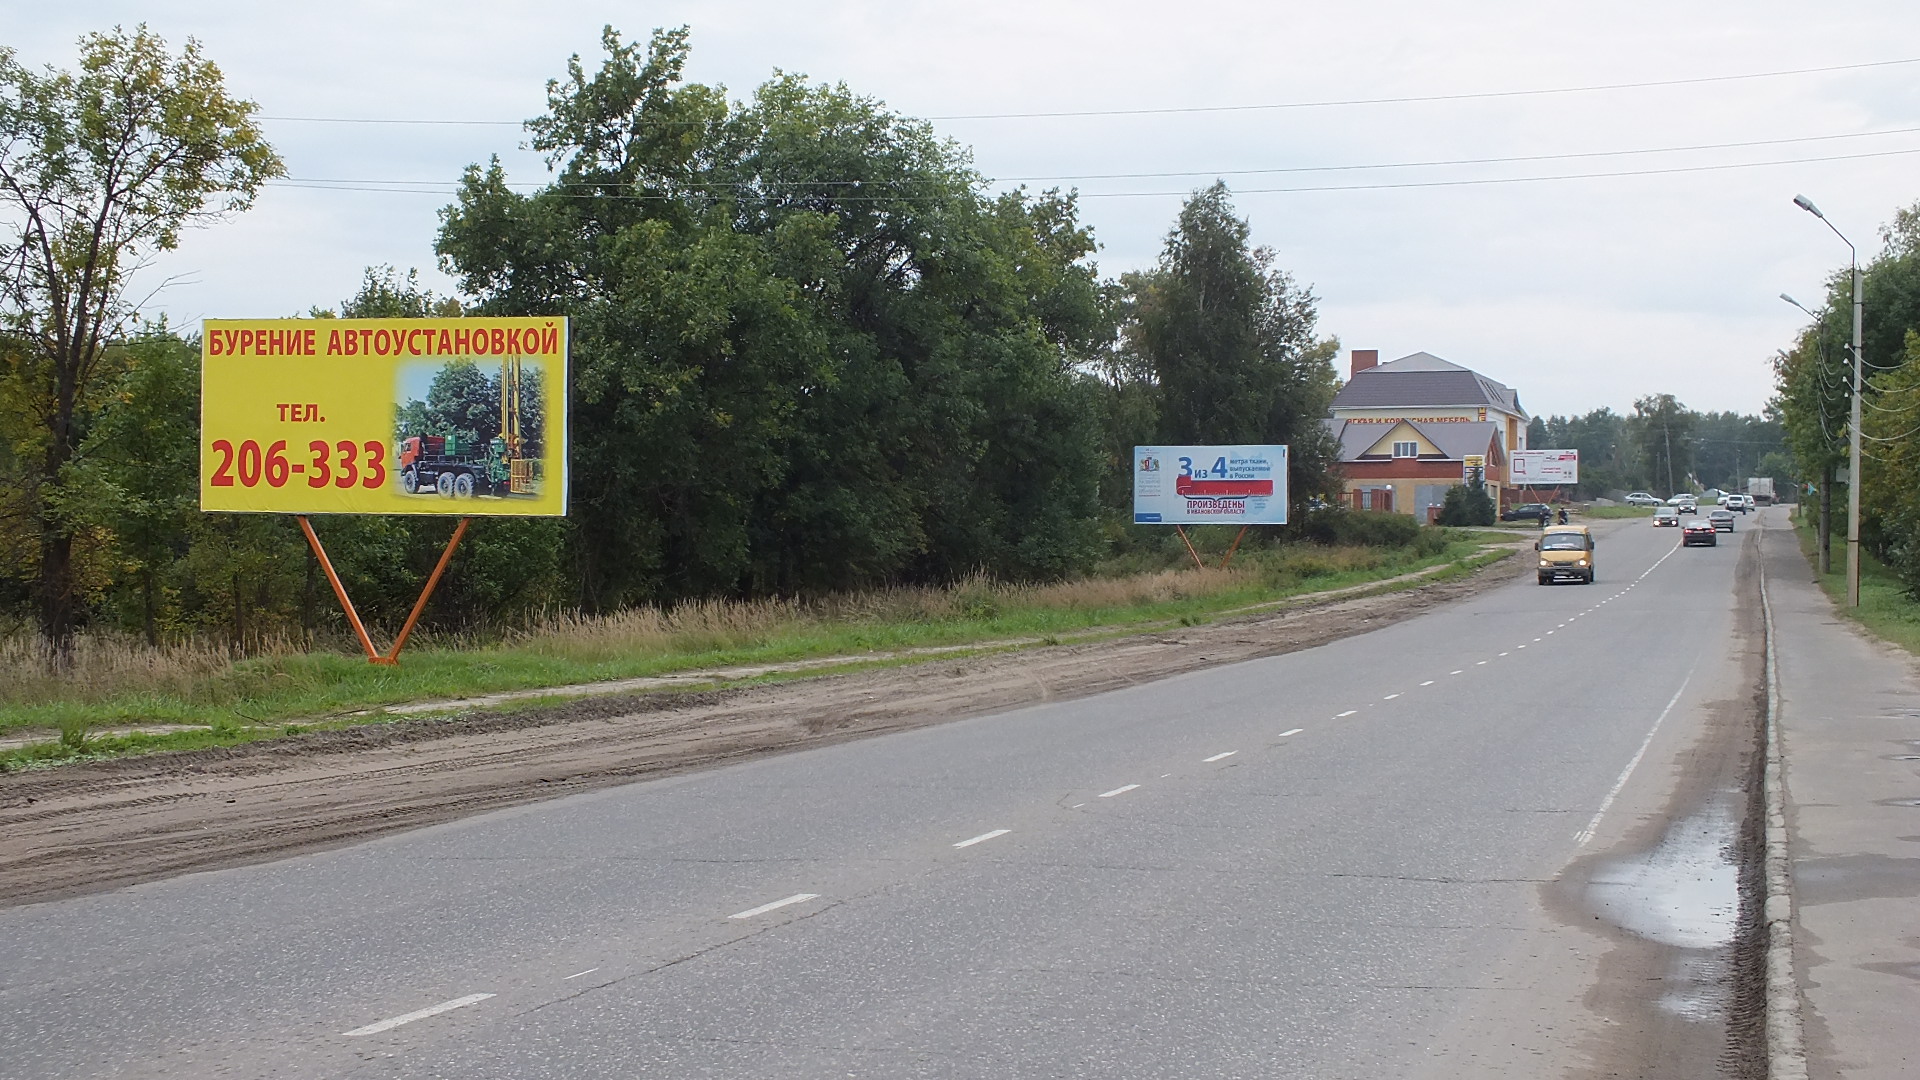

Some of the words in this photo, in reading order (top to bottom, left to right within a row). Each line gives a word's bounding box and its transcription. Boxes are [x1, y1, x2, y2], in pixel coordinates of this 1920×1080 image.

[209, 329, 316, 356] БУРЕНИЕ
[327, 322, 558, 356] АВТОУСТАНОВКОЙ
[276, 403, 326, 422] ТЕЛ.
[210, 439, 386, 488] 206-333
[1178, 456, 1193, 476] 3
[1211, 456, 1228, 478] 4
[1187, 500, 1245, 510] ПРОИЗВЕДЕНЫ
